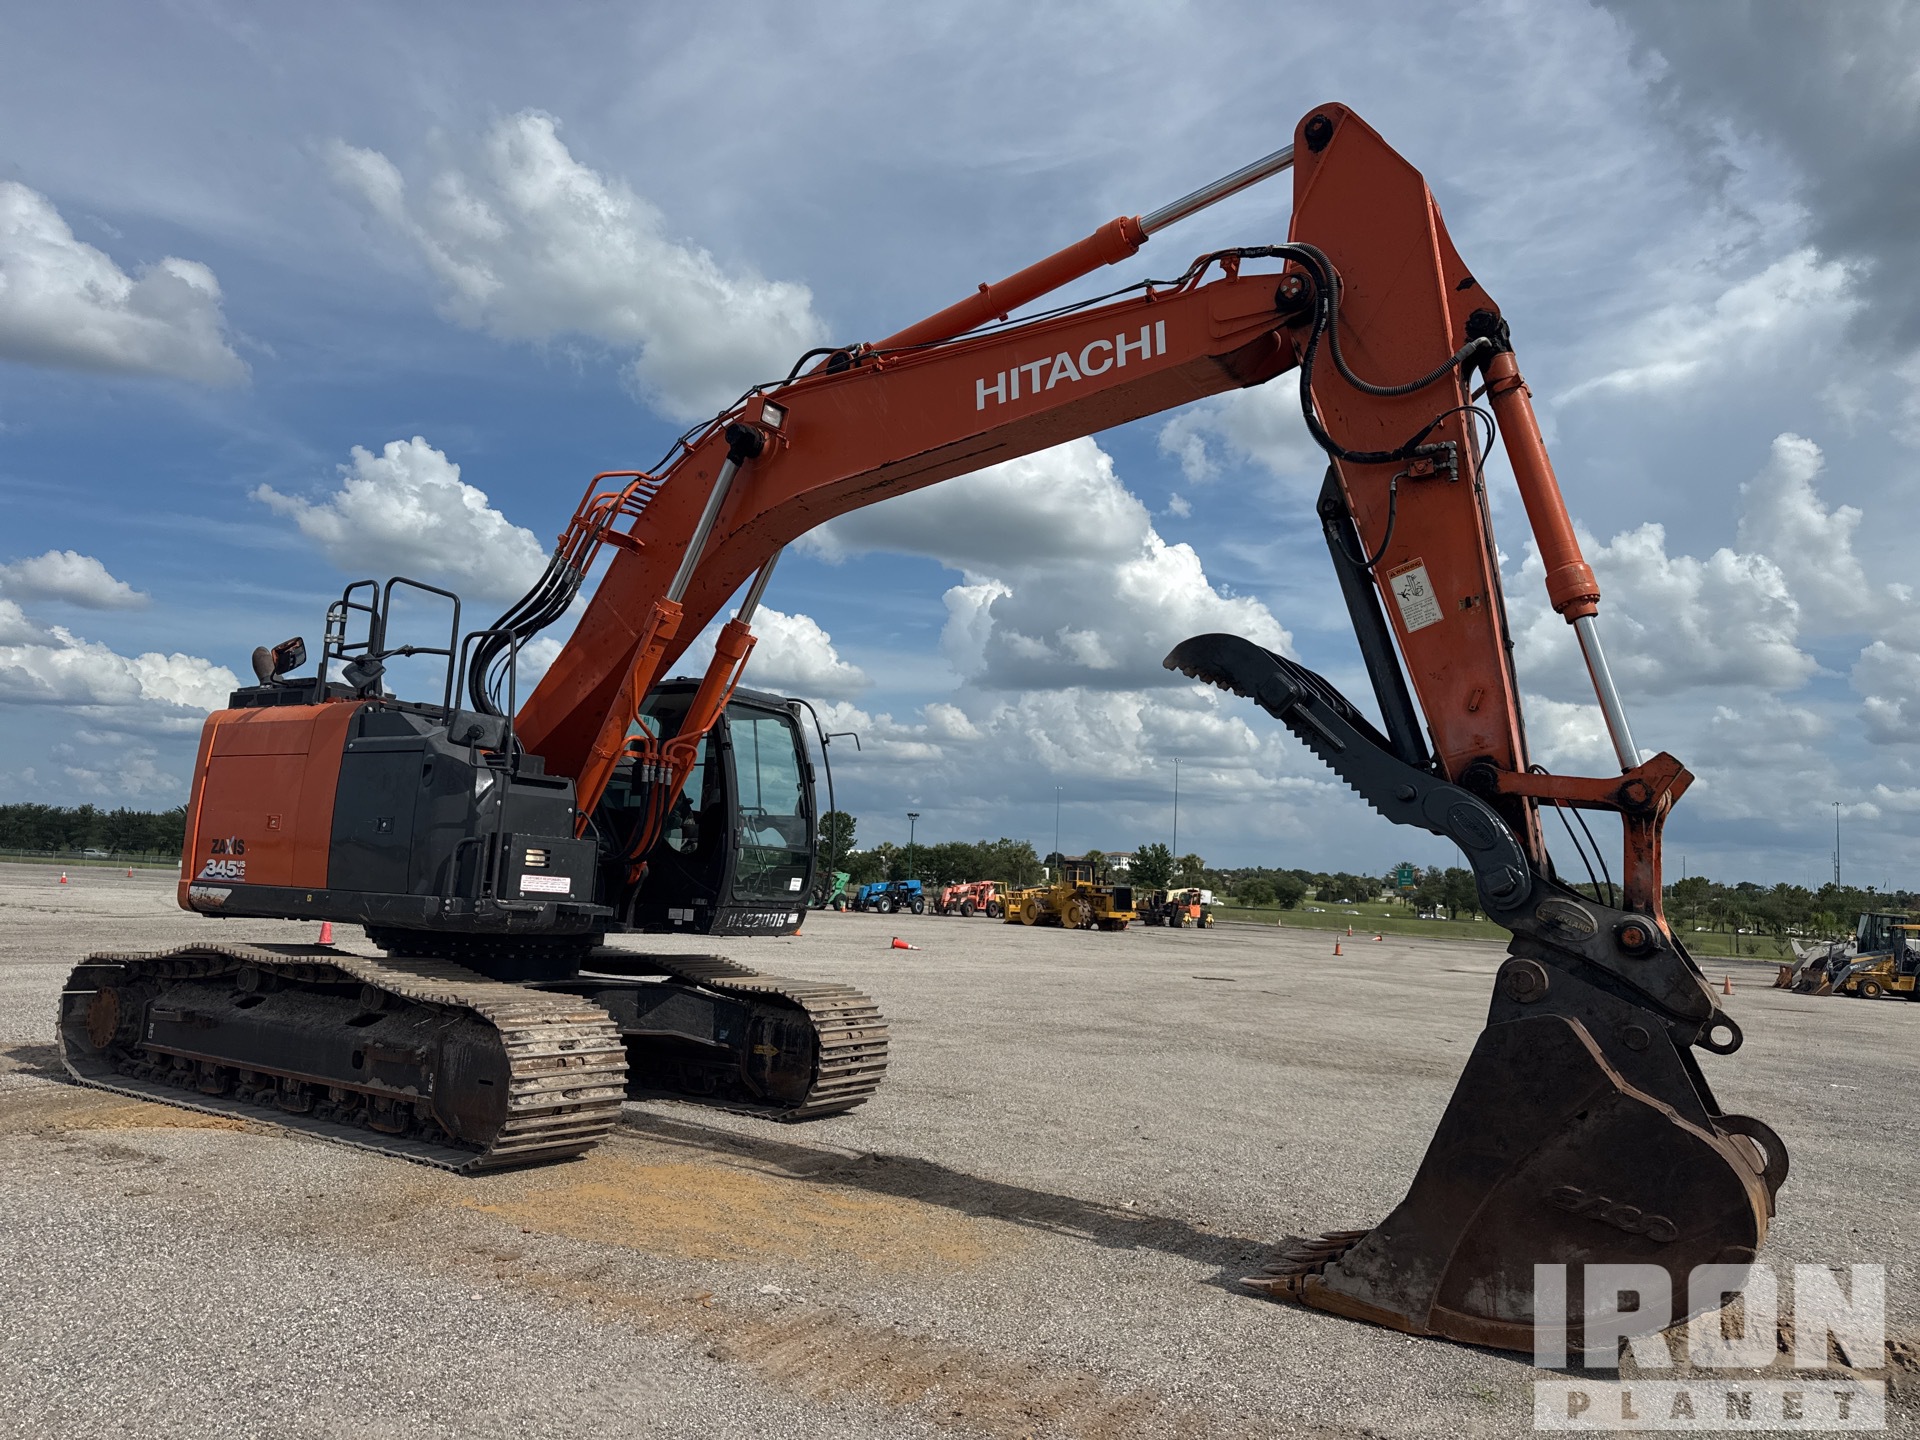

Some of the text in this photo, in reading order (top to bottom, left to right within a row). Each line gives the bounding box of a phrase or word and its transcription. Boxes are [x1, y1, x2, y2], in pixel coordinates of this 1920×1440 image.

[976, 320, 1166, 411] HITACHI
[211, 836, 245, 855] ZAXIS
[205, 859, 237, 877] 345
